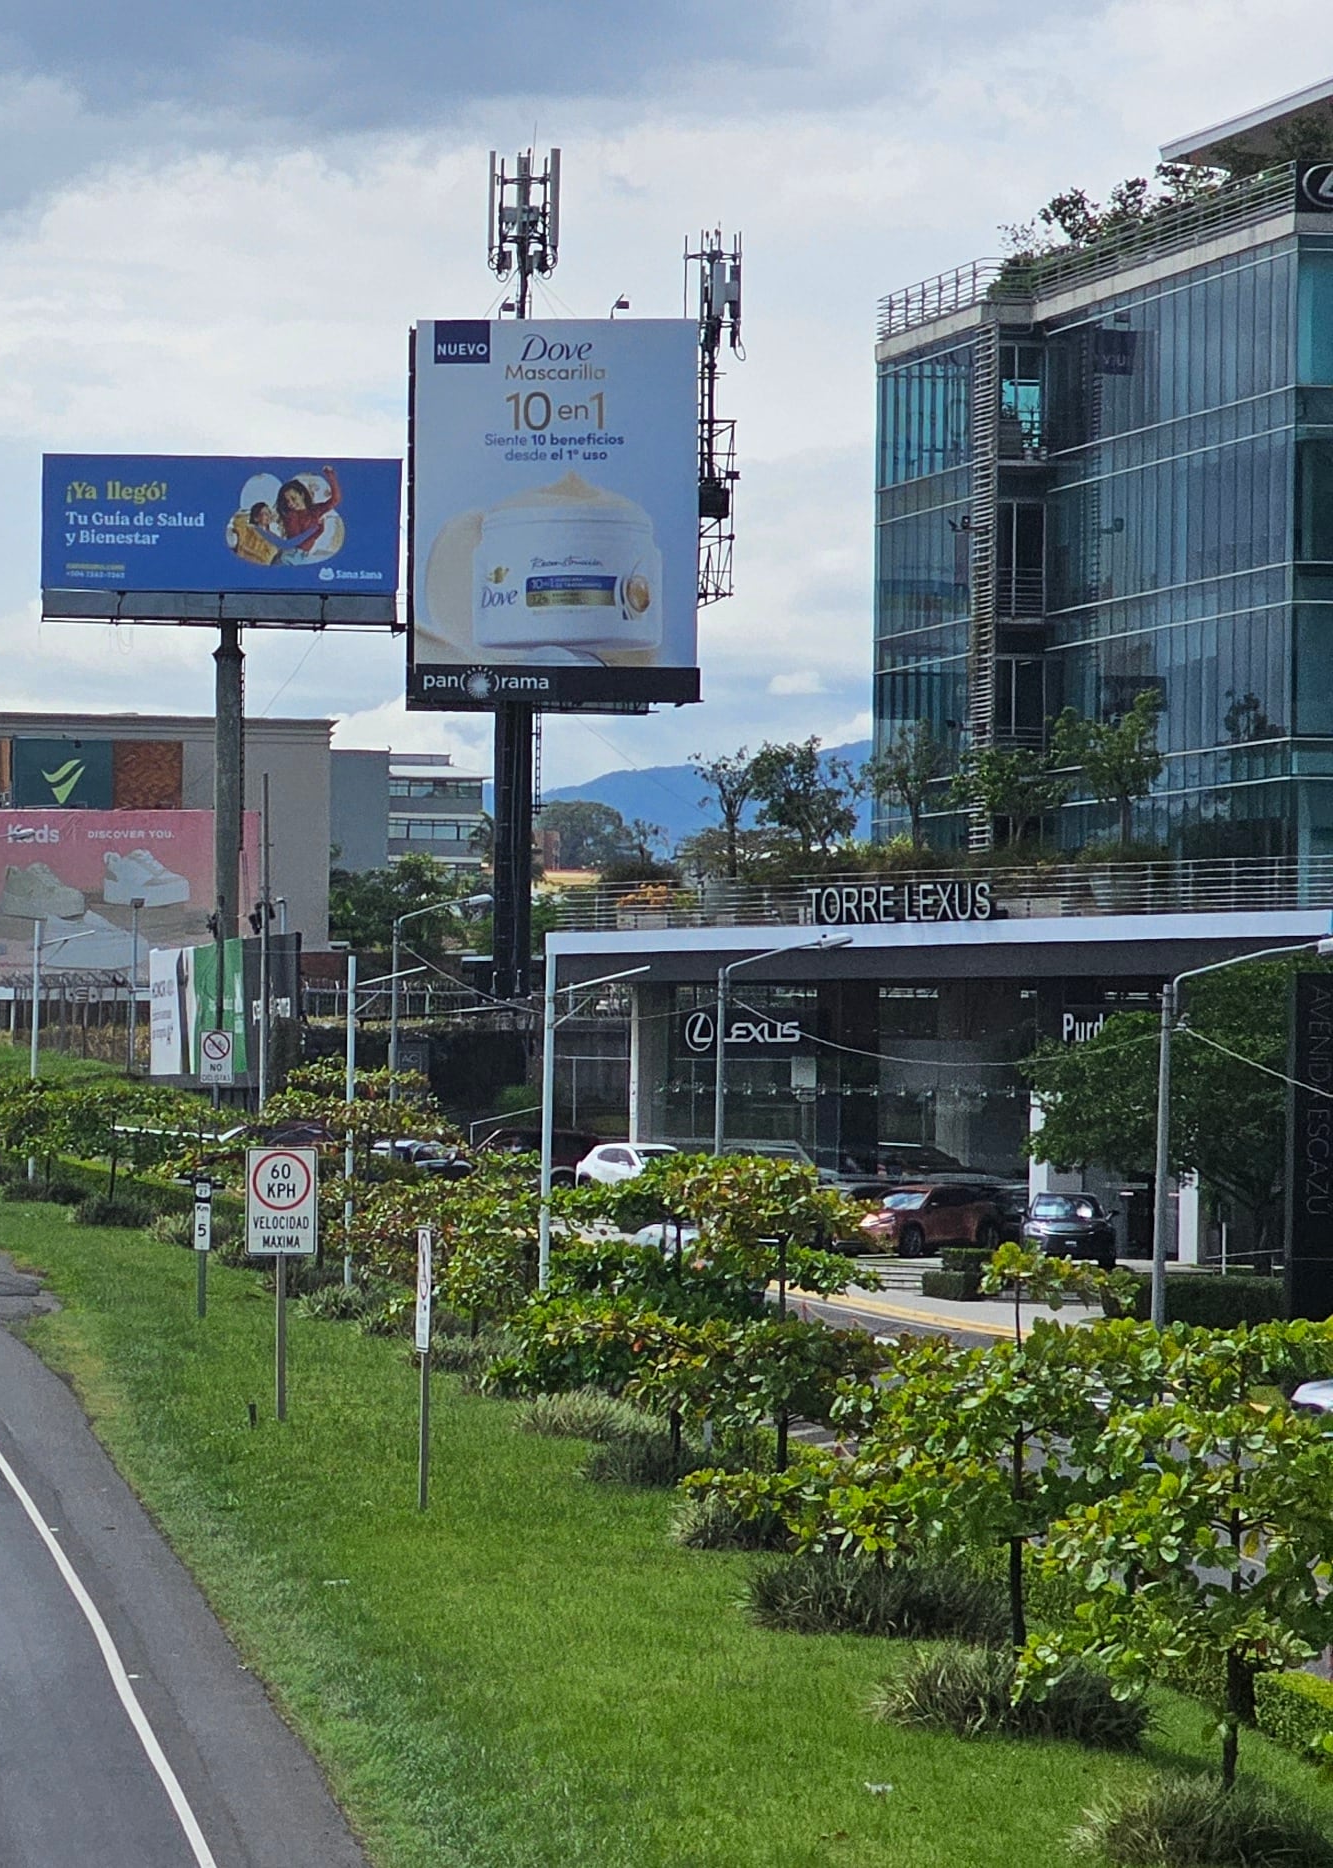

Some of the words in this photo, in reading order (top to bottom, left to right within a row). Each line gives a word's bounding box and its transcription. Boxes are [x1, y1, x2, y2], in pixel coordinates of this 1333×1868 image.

[436, 344, 488, 356] NUEVO
[521, 334, 593, 361] Dove
[505, 364, 606, 381] Mascarilla
[505, 391, 552, 431] 10
[558, 404, 589, 420] en
[589, 391, 605, 430] 1
[485, 433, 528, 447] Siente
[531, 434, 546, 446] 10
[550, 433, 624, 447] beneficios
[505, 449, 547, 461] desde
[550, 449, 563, 461] el
[583, 451, 608, 461] uso
[106, 480, 168, 504] llegó!
[65, 511, 88, 526] Tu
[91, 510, 130, 526] Guía
[133, 511, 154, 526] de
[157, 512, 205, 527] Salud
[65, 532, 76, 547] y
[79, 529, 160, 545] Bienestar
[481, 585, 518, 609] Dove
[87, 830, 145, 839] DISCOVER
[149, 830, 175, 839] YOU.
[806, 885, 895, 924] TORRE
[904, 882, 991, 922] LEXUS
[1062, 1012, 1104, 1043] Purd
[1307, 984, 1333, 1098] AVENIDA
[209, 1064, 223, 1072] NO
[270, 1163, 291, 1180] 60
[267, 1183, 296, 1199] KPH
[197, 1223, 207, 1237] 5
[253, 1216, 310, 1230] VELOCIDAD
[262, 1235, 301, 1248] MAXIMA
